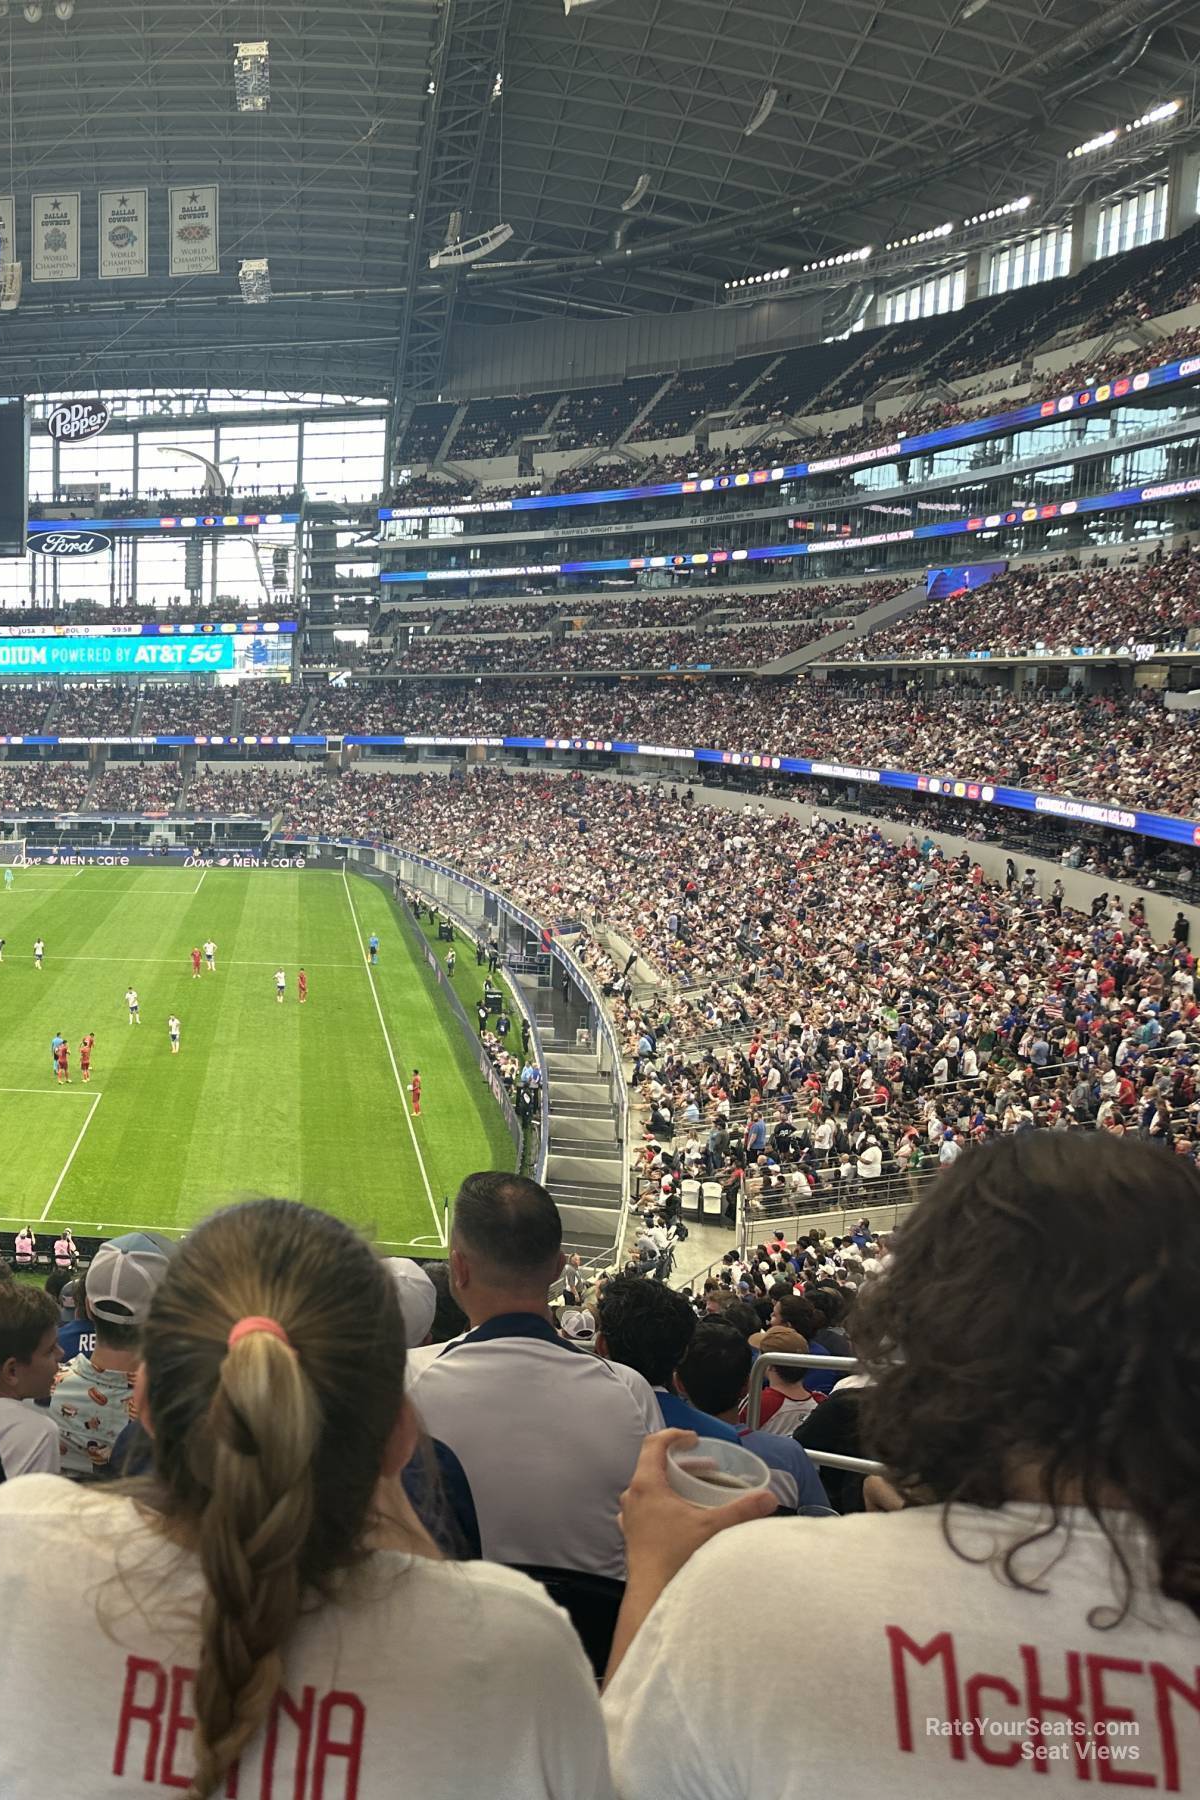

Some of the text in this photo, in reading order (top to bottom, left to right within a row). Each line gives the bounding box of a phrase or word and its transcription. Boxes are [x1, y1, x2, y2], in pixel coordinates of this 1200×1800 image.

[182, 205, 206, 213] DALLAS
[44, 212, 68, 220] DALLAS
[179, 212, 209, 220] COWBOYS
[103, 260, 144, 268] CHAMPIONS
[174, 256, 214, 264] CHAMPIONS
[70, 404, 92, 421] Dr
[431, 505, 449, 515] COPA
[449, 503, 479, 513] AMERICA
[562, 528, 588, 536] RAYFIELD
[590, 526, 612, 534] WRIGHT
[42, 534, 94, 552] Ford
[51, 648, 111, 662] POWERED
[116, 648, 131, 662] BY
[134, 646, 186, 664] AT&T
[187, 644, 223, 663] 5G
[12, 854, 42, 866] Dove
[60, 856, 86, 865] MEN
[97, 856, 130, 866] care
[184, 856, 214, 868] Dove
[233, 858, 260, 868] MEN
[271, 858, 306, 868] care
[112, 1654, 366, 1800] RENA
